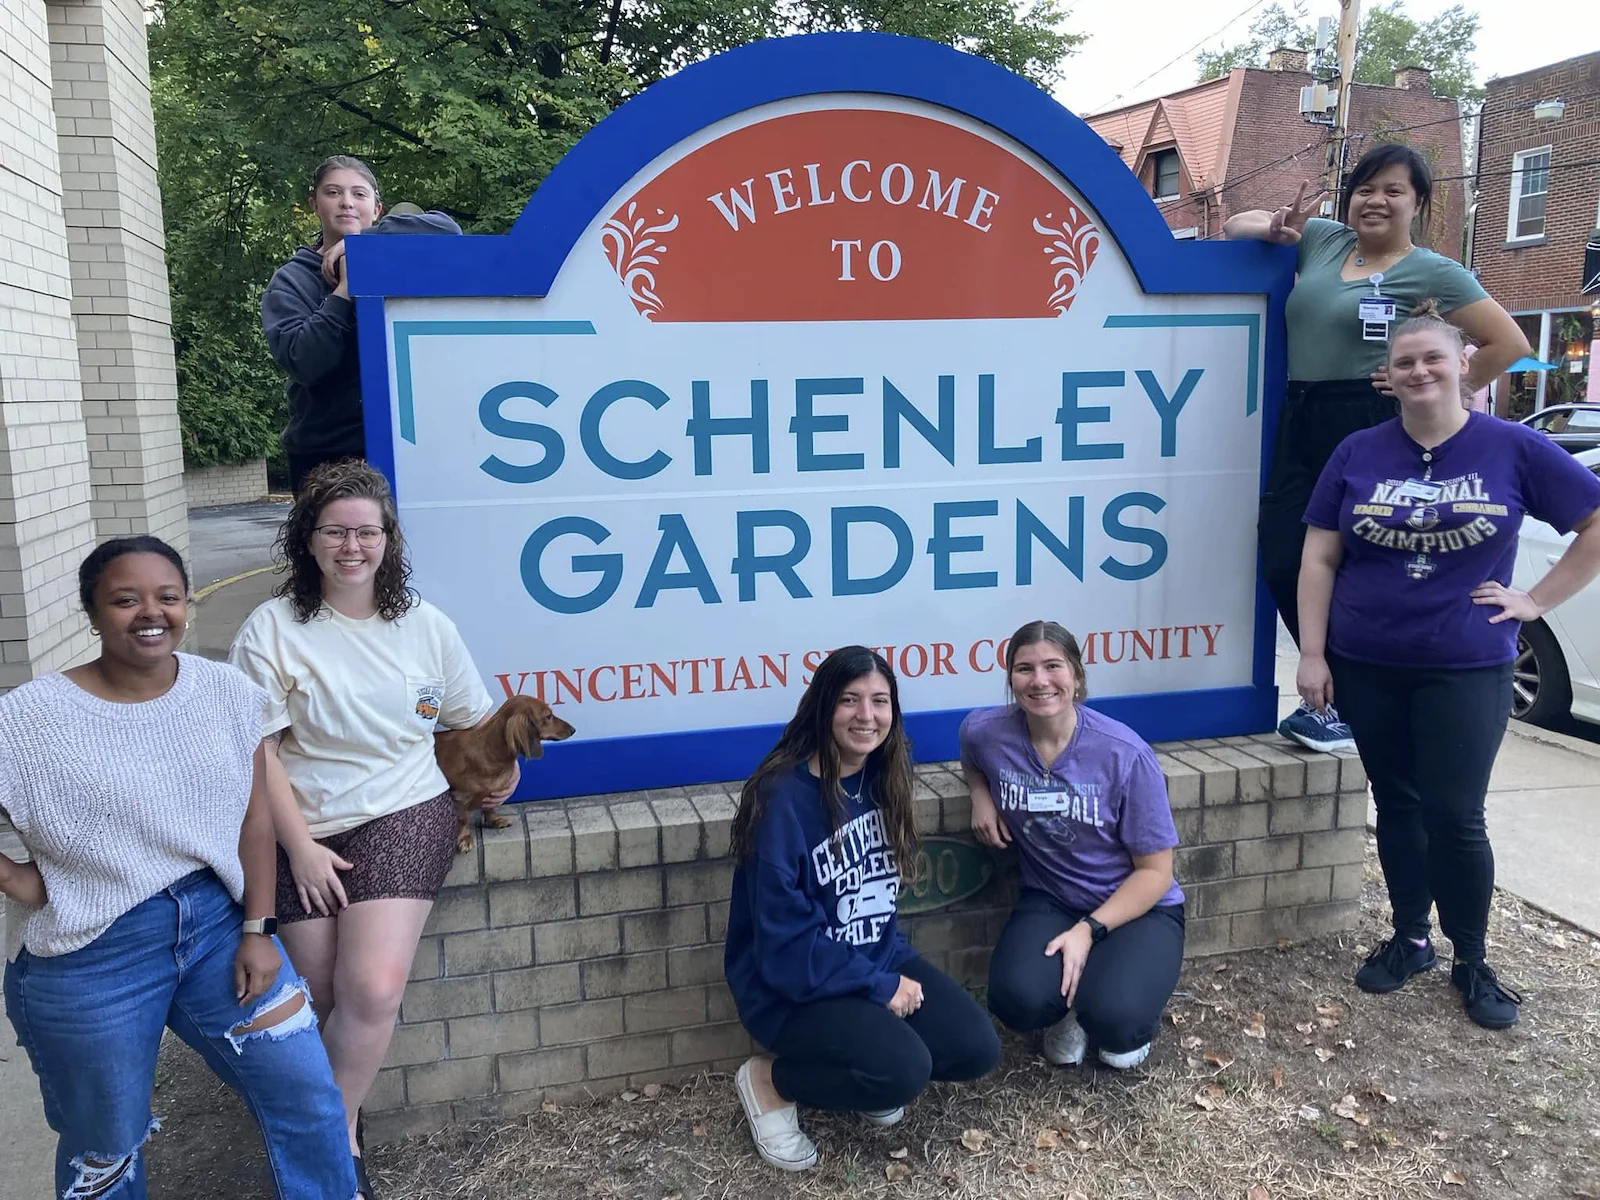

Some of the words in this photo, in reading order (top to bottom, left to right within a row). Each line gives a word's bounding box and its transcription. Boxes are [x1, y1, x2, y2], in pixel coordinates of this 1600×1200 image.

[707, 159, 1001, 233] WELCOME
[831, 238, 902, 282] TO
[478, 368, 1206, 484] SCHENLEY
[1368, 478, 1491, 508] NANAL
[519, 491, 1169, 615] GARDENS
[1352, 515, 1498, 553] CHAMPIONS
[494, 652, 791, 706] VINCENTIAN
[802, 642, 957, 686] SIOR
[968, 623, 1225, 673] CUNITY
[999, 780, 1105, 828] VOLALL
[811, 808, 889, 887] GETTYSB
[835, 850, 899, 897] COLLEG
